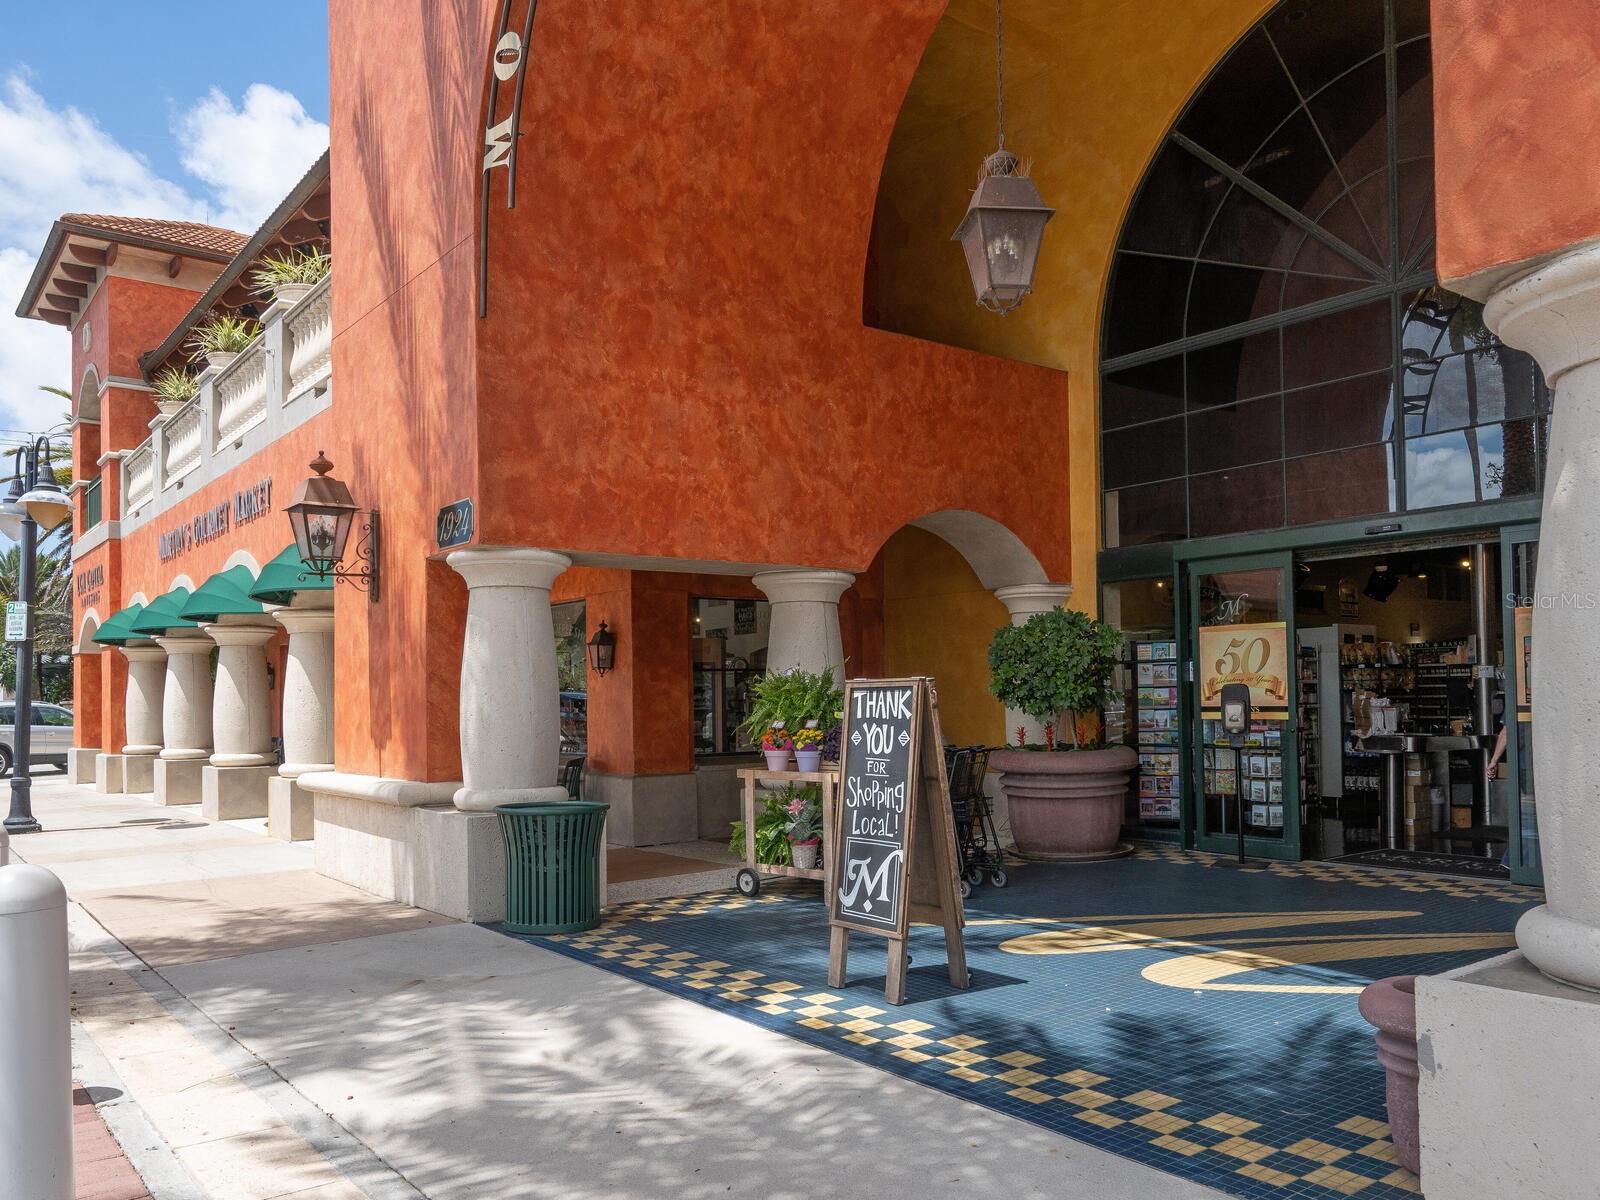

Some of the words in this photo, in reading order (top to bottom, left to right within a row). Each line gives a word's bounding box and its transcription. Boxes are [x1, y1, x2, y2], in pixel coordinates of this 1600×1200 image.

[8, 604, 14, 613] 2
[1215, 637, 1271, 675] 50
[853, 688, 912, 720] THANK
[863, 722, 895, 755] YOU
[867, 760, 886, 774] FOR
[838, 849, 903, 908] M
